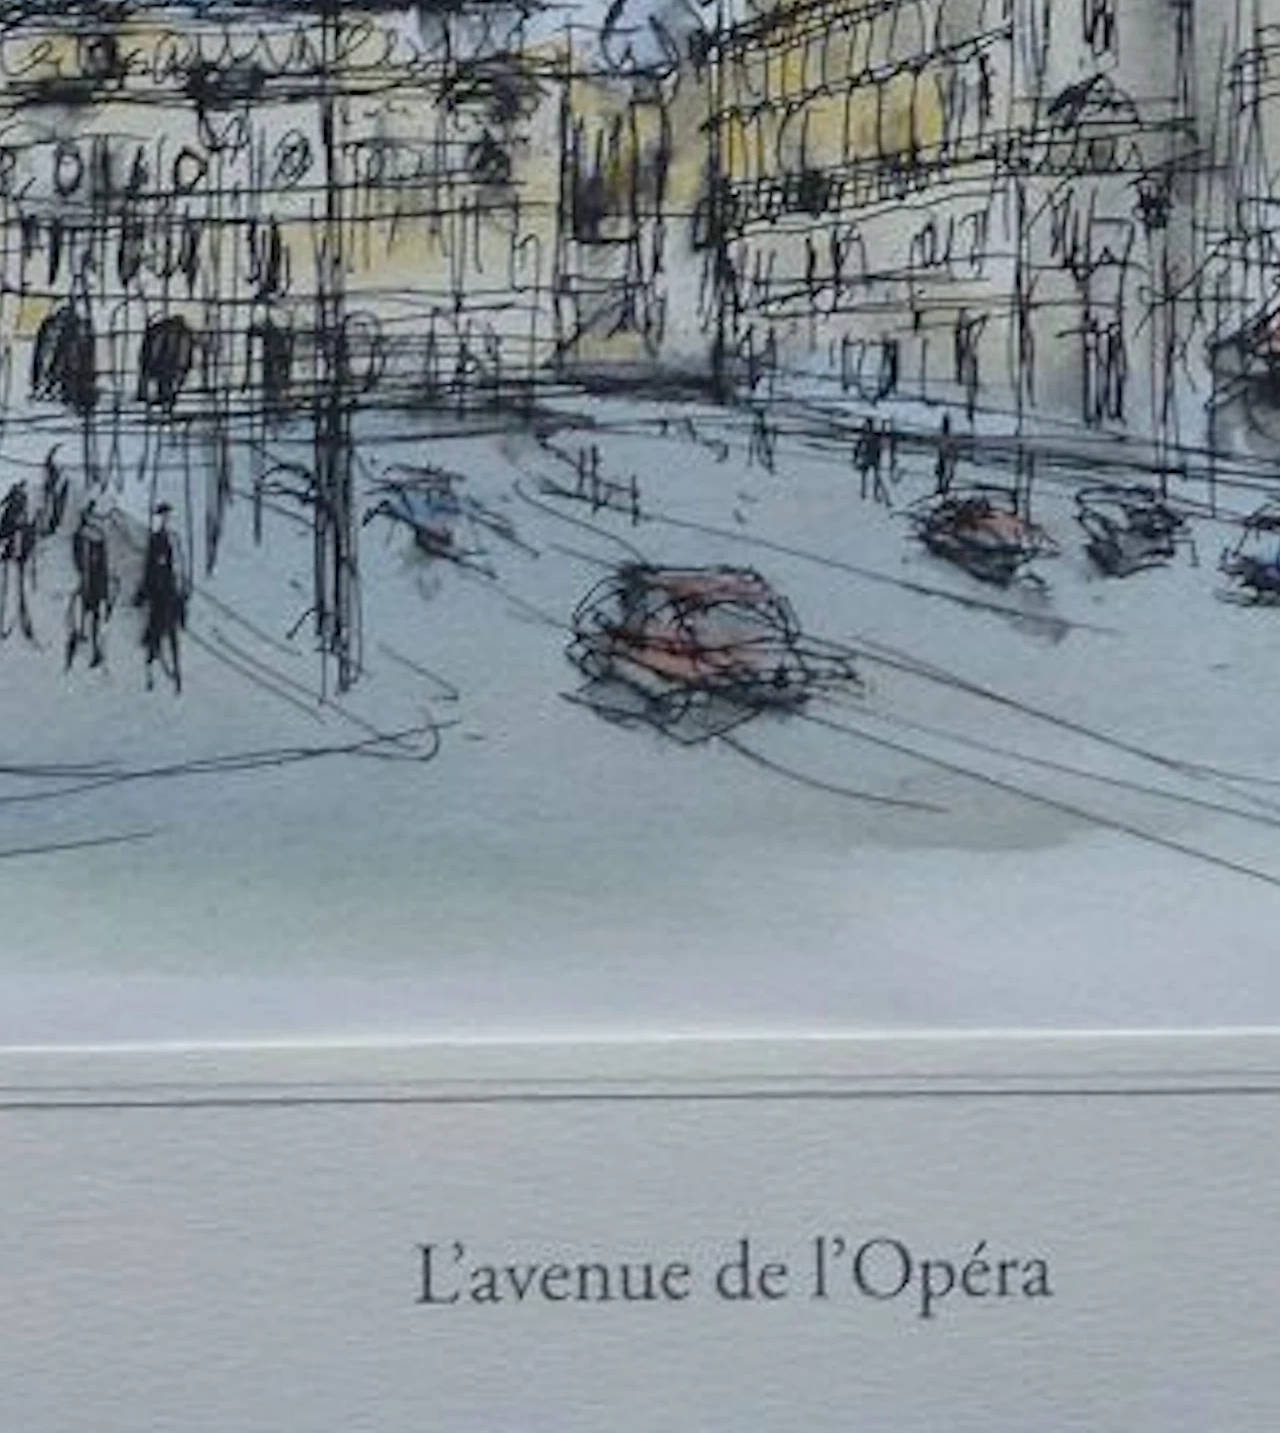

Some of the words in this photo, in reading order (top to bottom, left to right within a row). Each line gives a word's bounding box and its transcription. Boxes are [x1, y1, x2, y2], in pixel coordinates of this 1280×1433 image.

[416, 1241, 691, 1305] L’avenue
[715, 1238, 788, 1301] de
[813, 1236, 1053, 1320] l’Opéra
